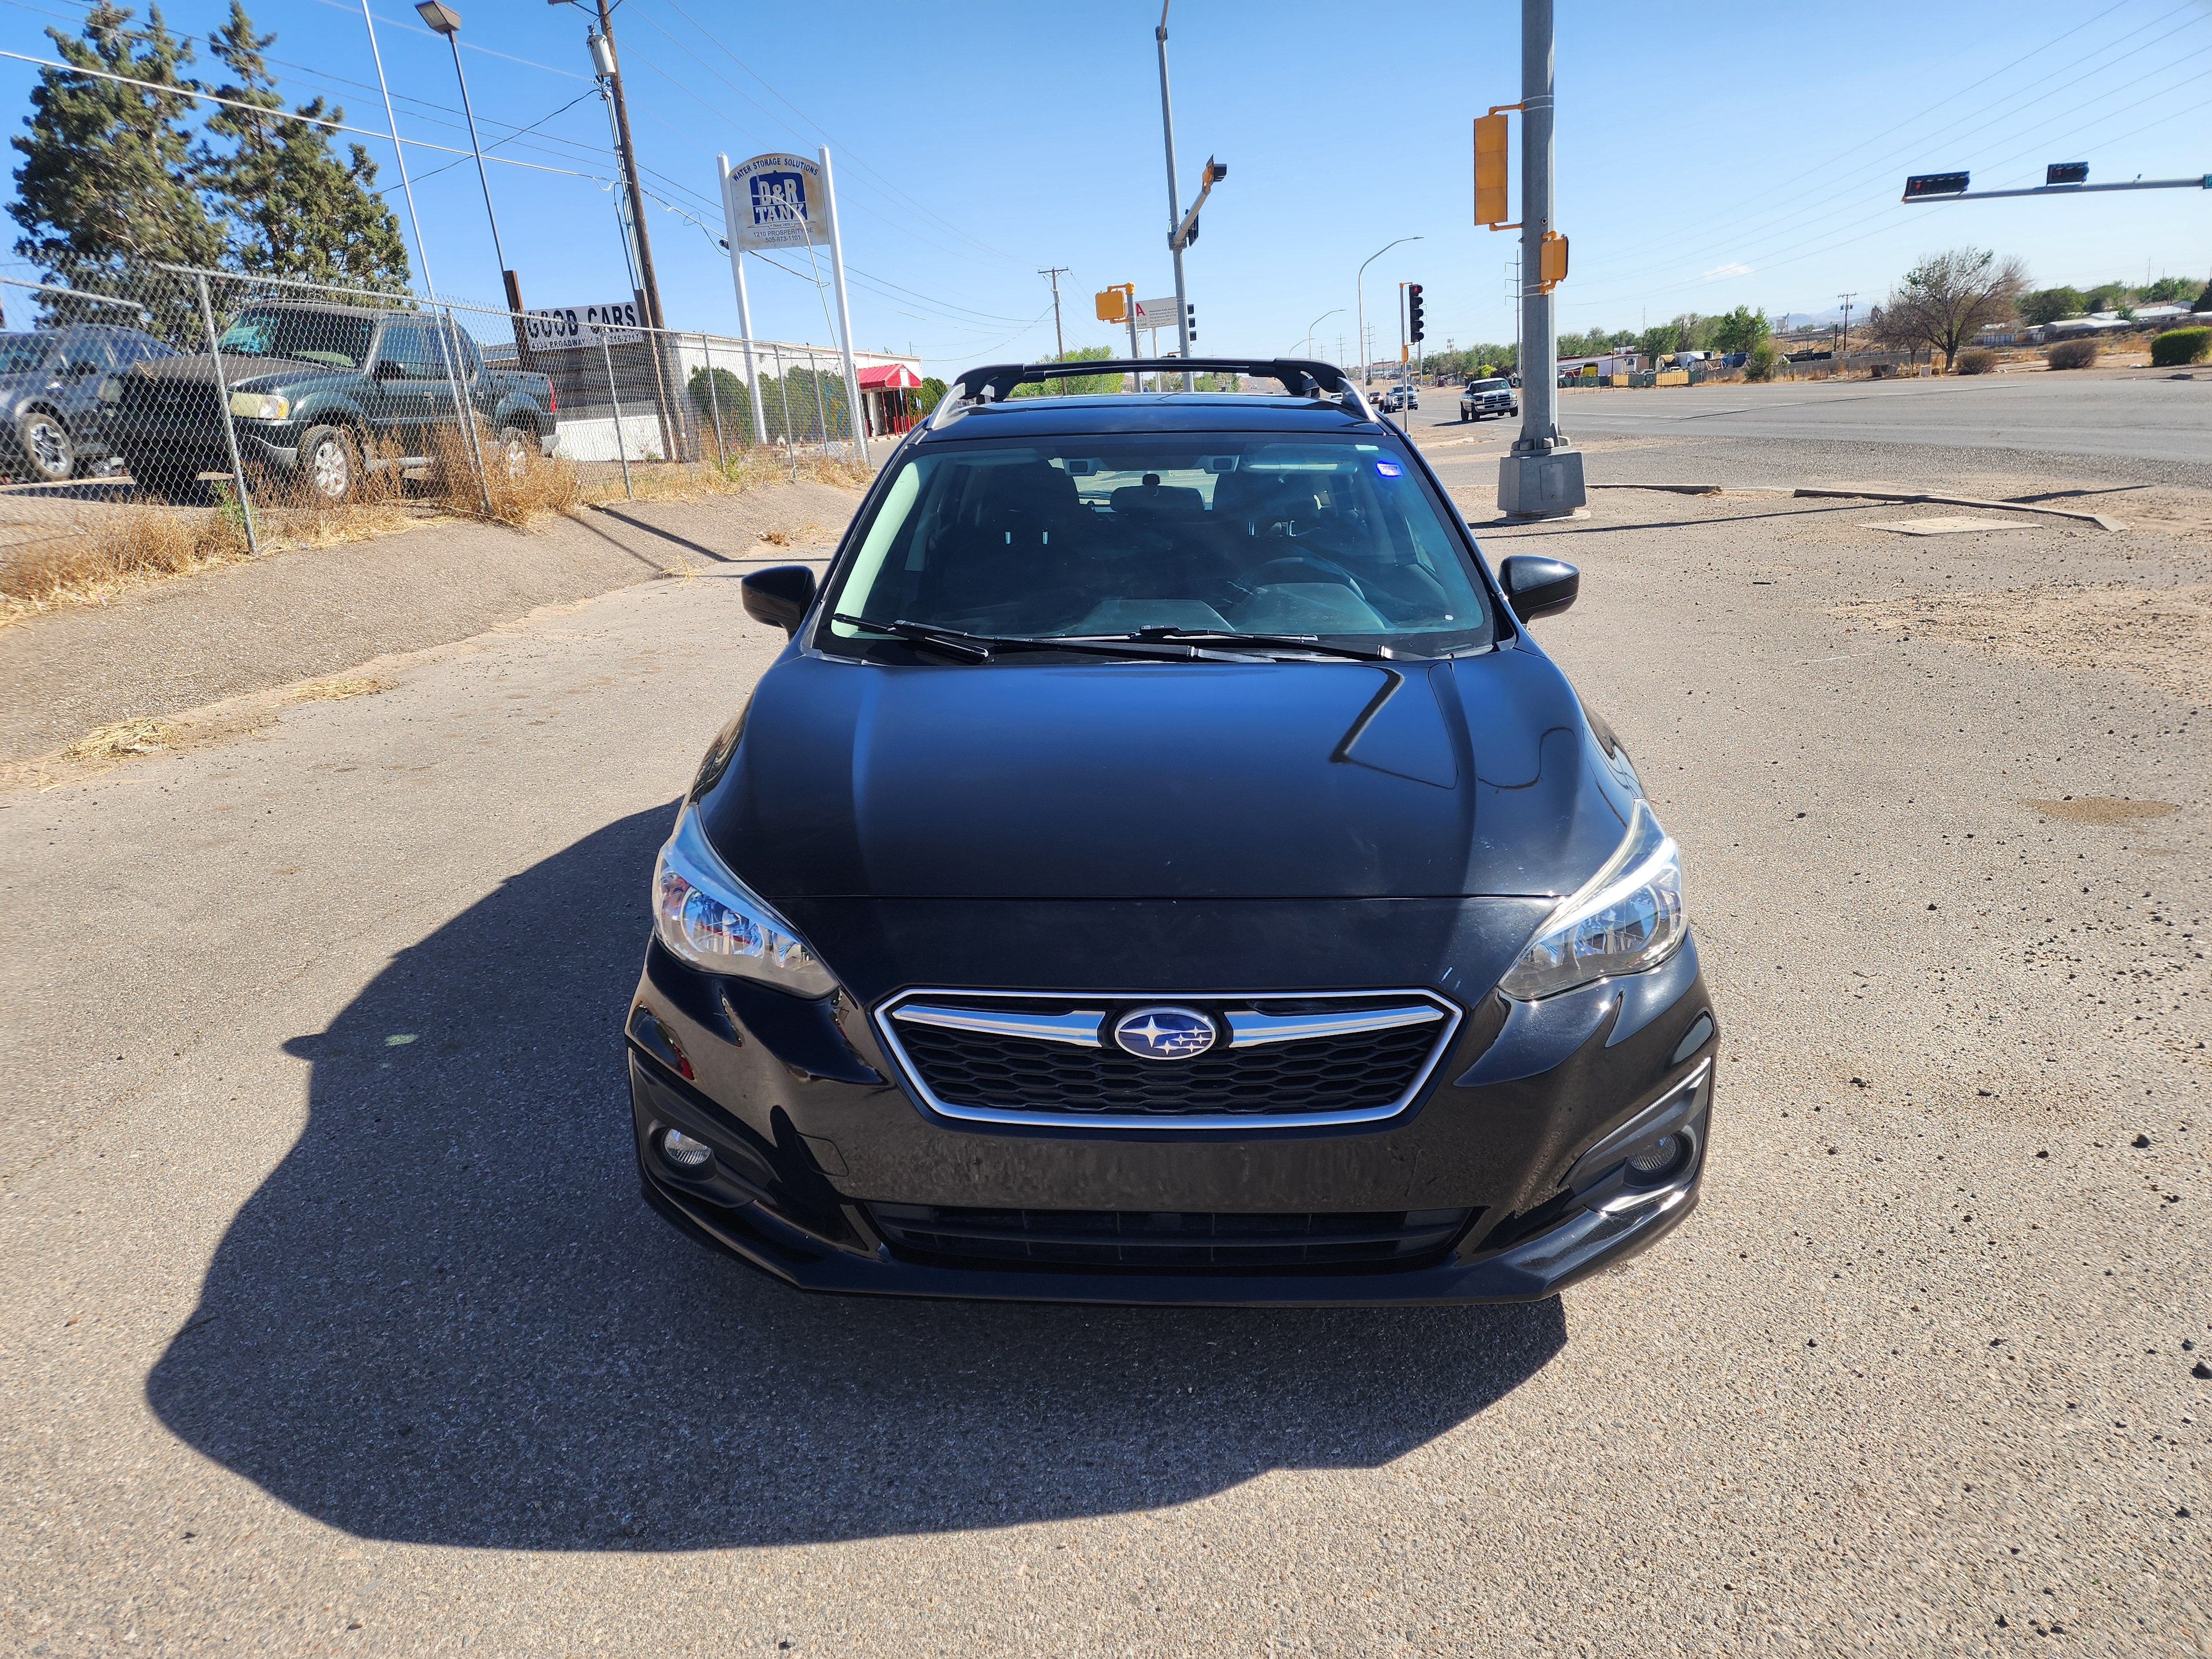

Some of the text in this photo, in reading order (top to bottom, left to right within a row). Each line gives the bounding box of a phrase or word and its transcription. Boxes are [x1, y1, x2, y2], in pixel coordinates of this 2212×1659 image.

[732, 158, 818, 181] WATER STORAGE SOLUTIONS
[759, 179, 799, 205] D&R
[755, 203, 806, 223] TANK
[526, 304, 637, 338] GOOD CARS
[549, 338, 585, 348] BROADWAY
